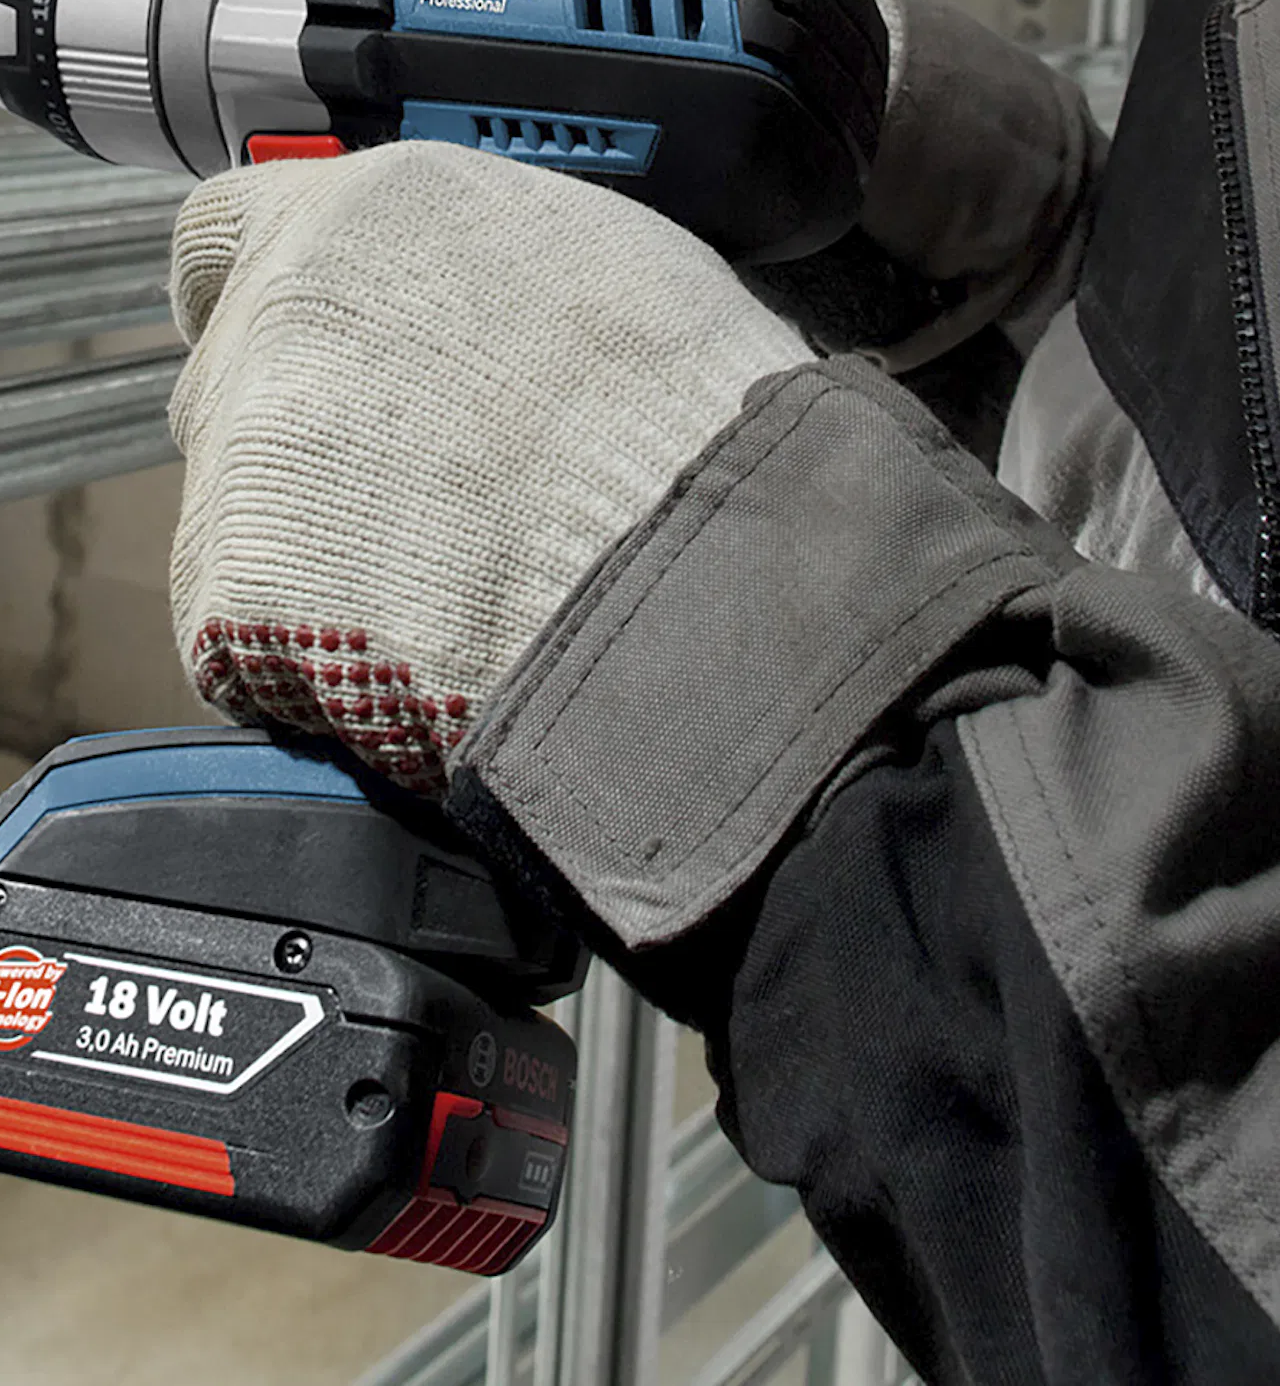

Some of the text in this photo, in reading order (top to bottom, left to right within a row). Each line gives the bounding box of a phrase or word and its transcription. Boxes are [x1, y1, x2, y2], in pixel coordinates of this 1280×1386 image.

[43, 964, 65, 983] by
[84, 975, 228, 1037] 18 Volt
[75, 1025, 234, 1077] 3,0 Ah Premium
[503, 1047, 559, 1103] BOSCH
